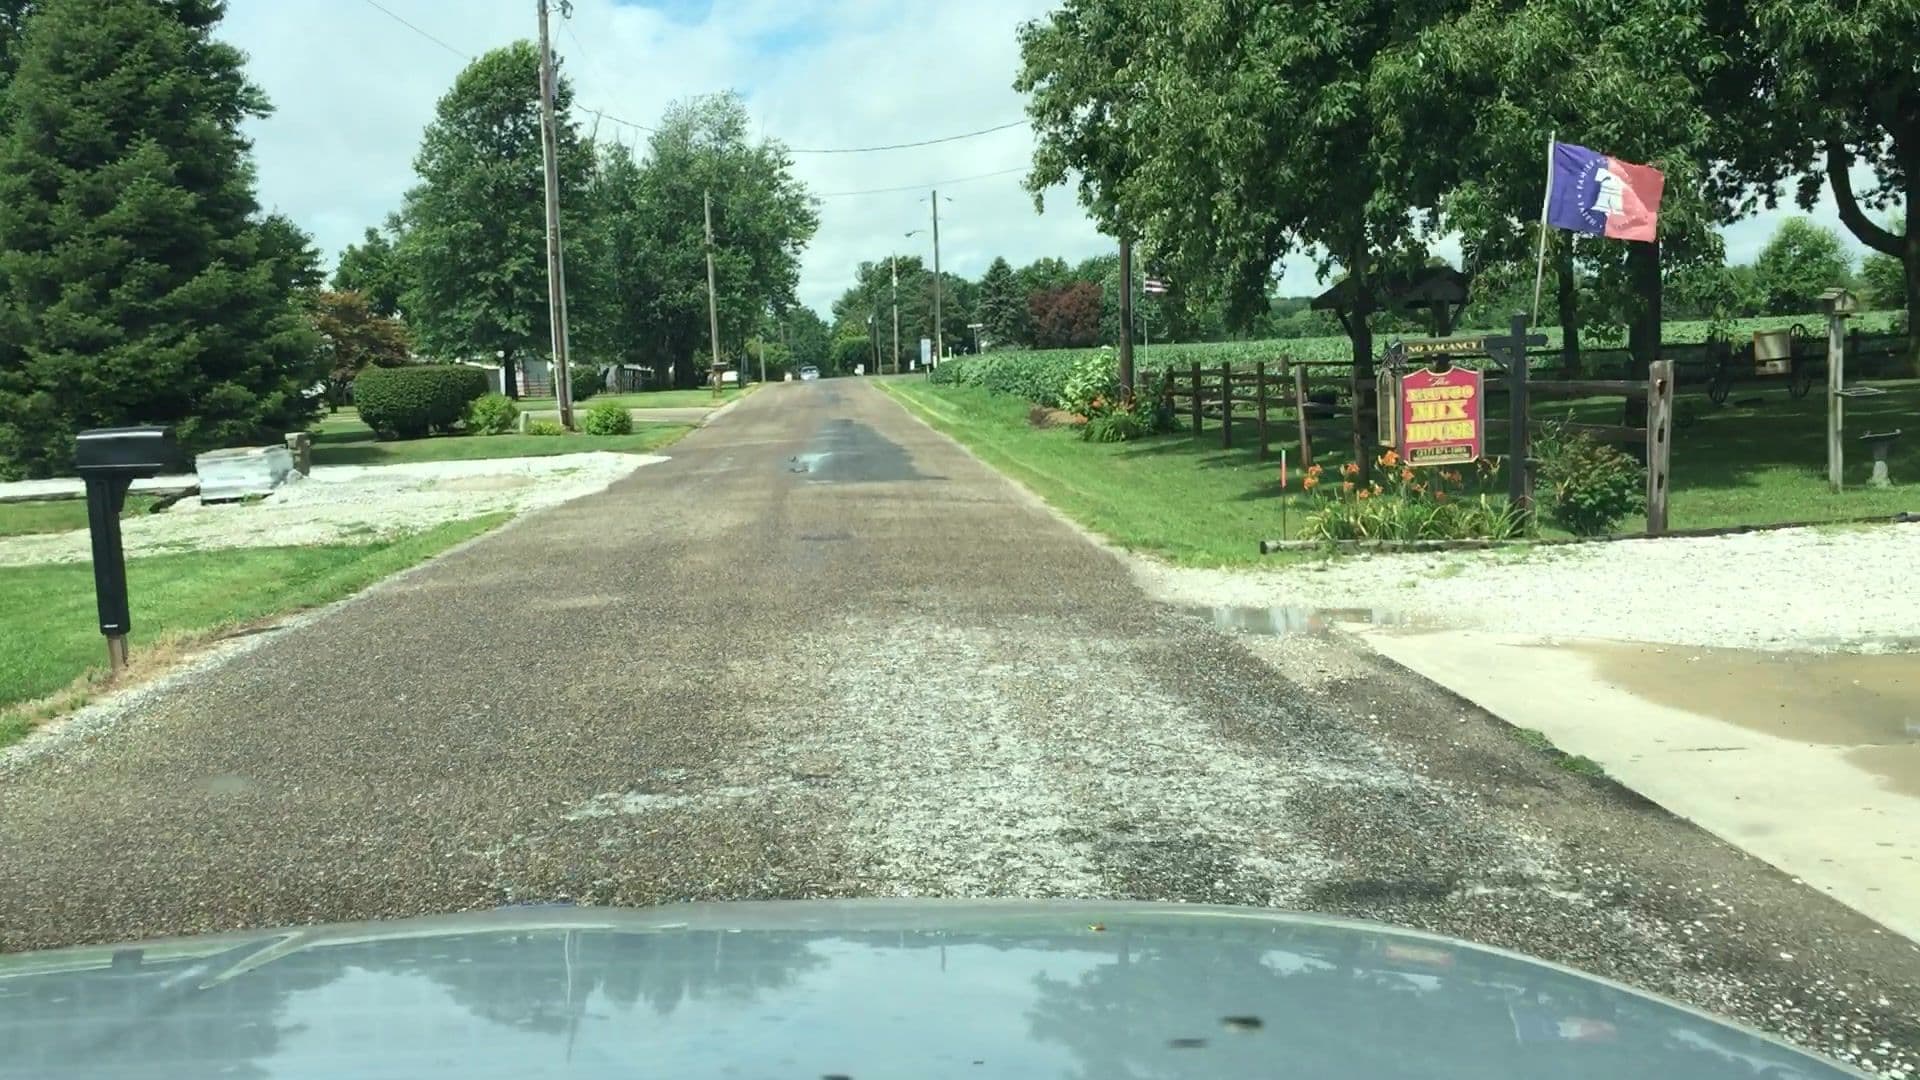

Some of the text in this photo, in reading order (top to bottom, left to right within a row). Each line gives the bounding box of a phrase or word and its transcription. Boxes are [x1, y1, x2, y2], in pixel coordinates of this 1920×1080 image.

[1427, 342, 1478, 351] VACANCY
[1428, 377, 1450, 386] The
[1411, 400, 1468, 422] MIX
[1406, 420, 1475, 443] HOUSE
